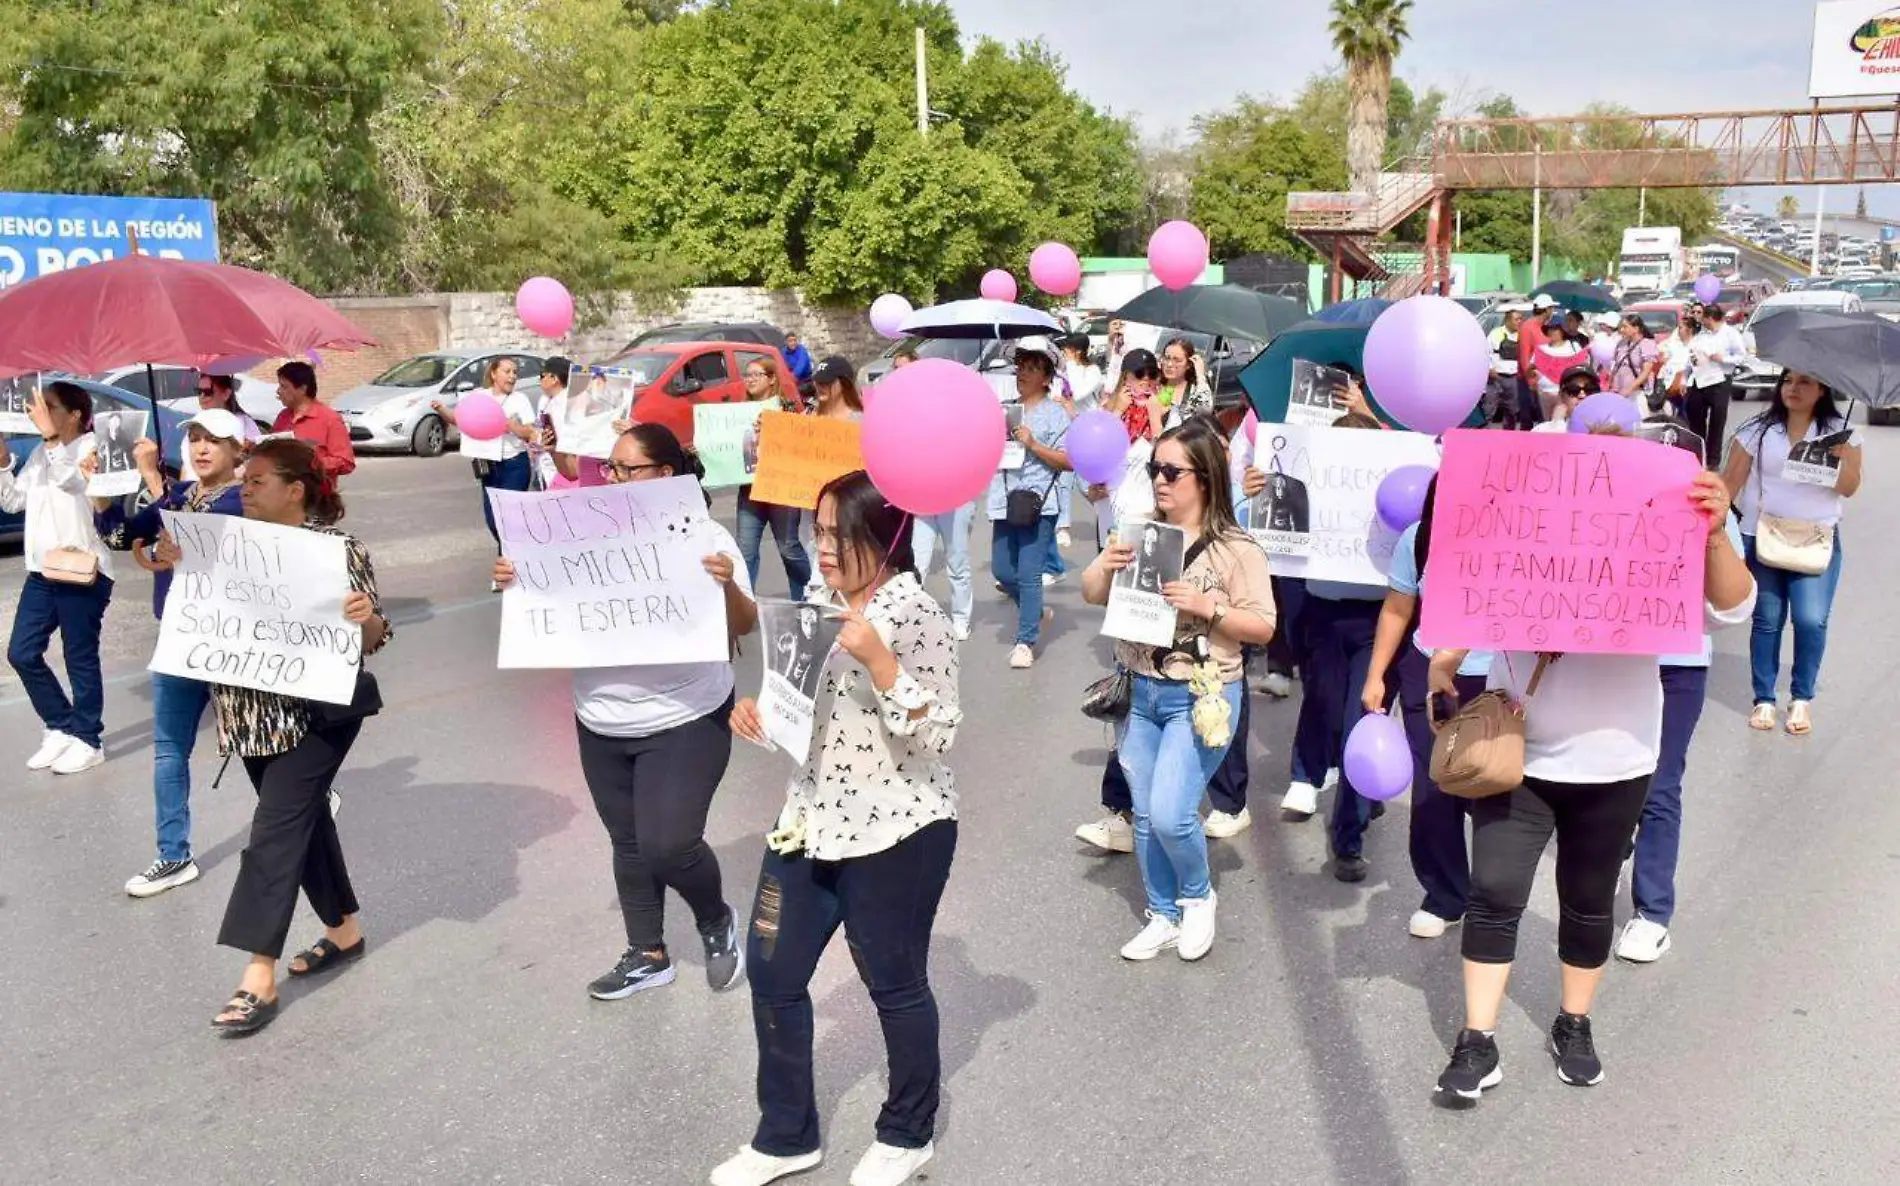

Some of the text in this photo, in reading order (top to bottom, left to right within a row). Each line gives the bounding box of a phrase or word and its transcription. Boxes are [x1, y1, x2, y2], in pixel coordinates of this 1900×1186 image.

[0, 216, 52, 236] ENO
[58, 218, 86, 237] DE
[92, 219, 120, 238] LA
[1481, 451, 1613, 498] LUISITA
[495, 491, 657, 545] LUISA
[184, 571, 214, 601] no
[511, 543, 668, 592] TU MICHI
[1452, 551, 1482, 577] TU
[1494, 552, 1614, 587] FAMILIA
[525, 607, 558, 638] TE
[1461, 586, 1687, 631] DESCONSOLADA
